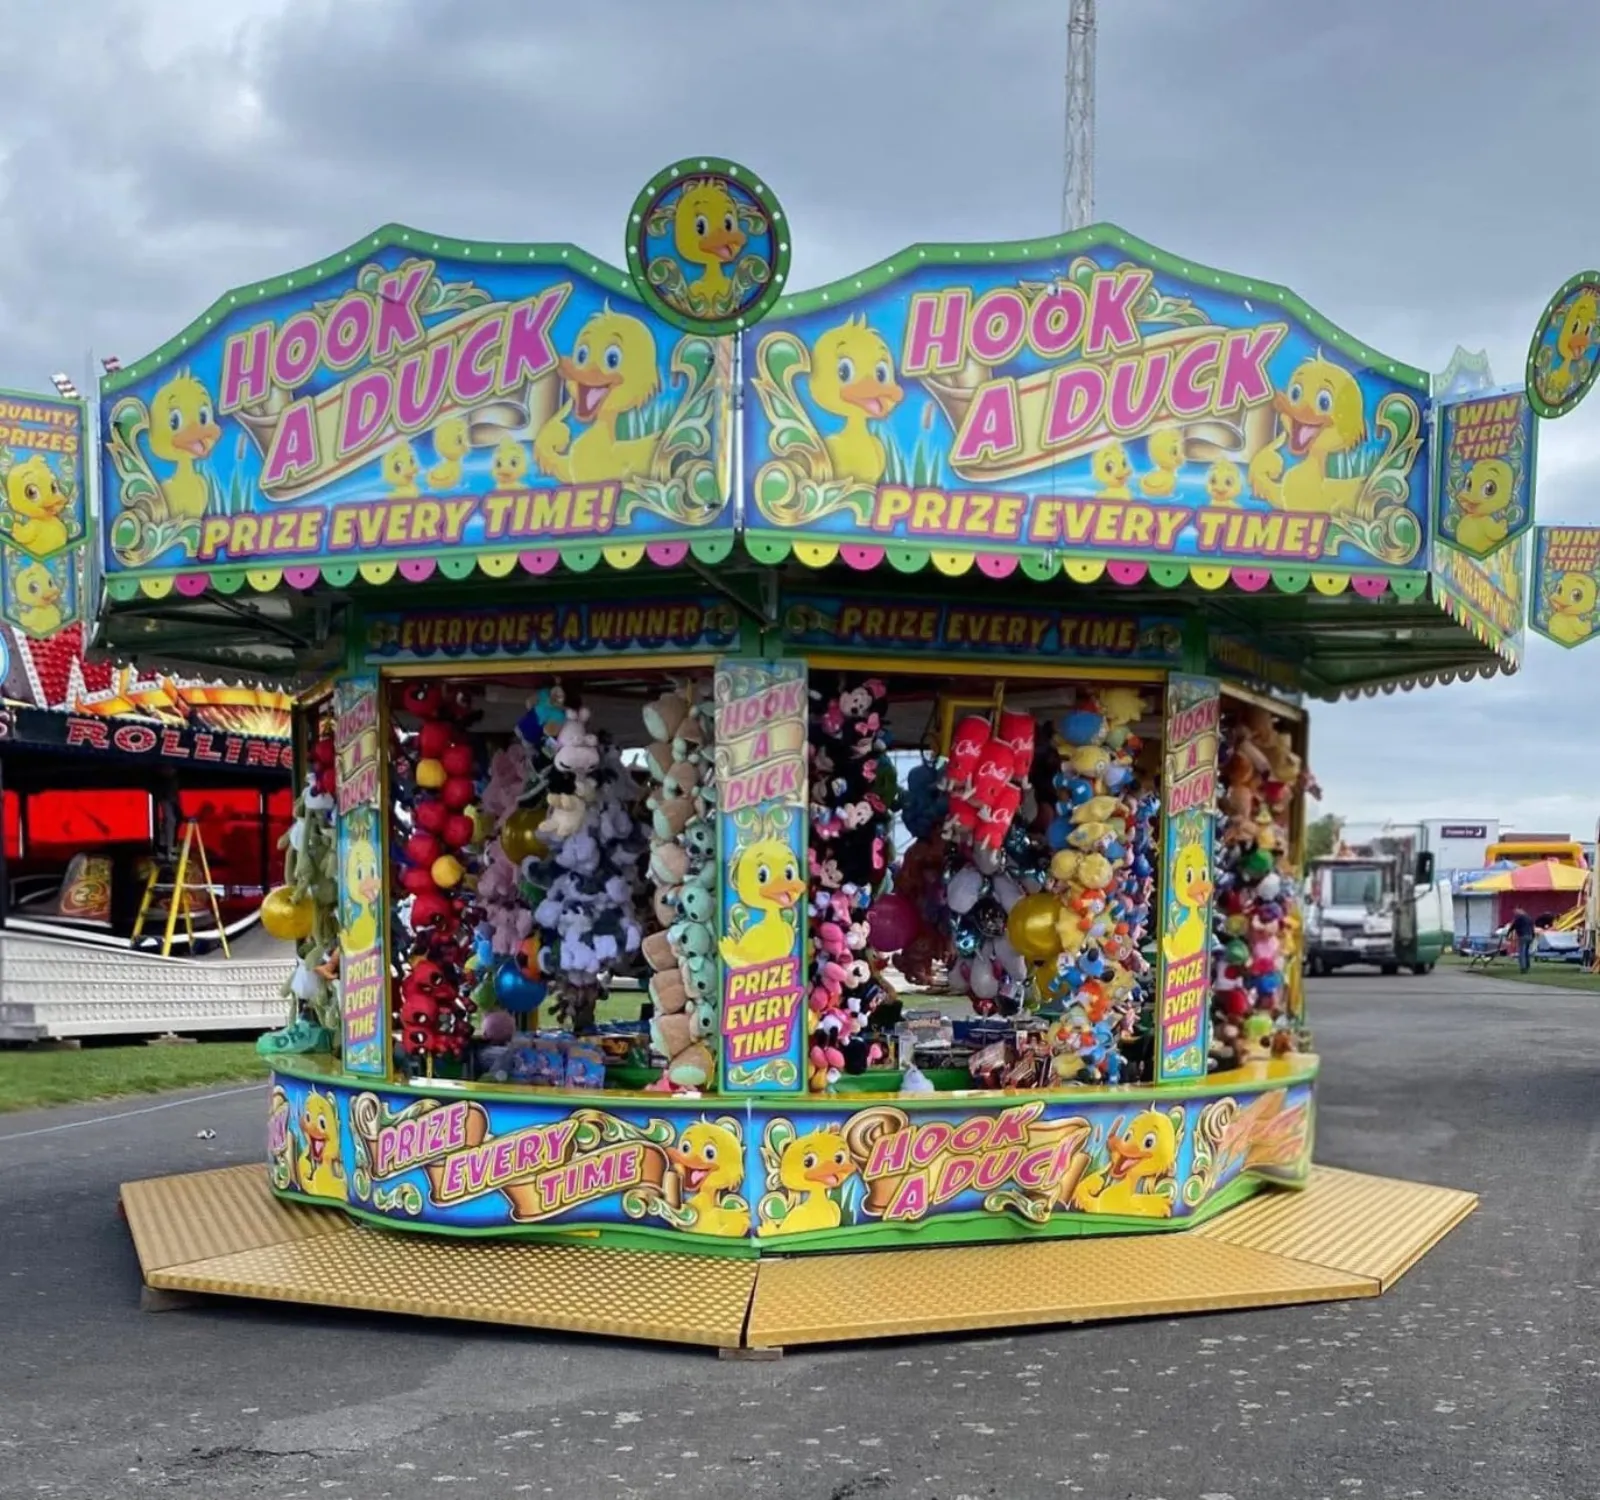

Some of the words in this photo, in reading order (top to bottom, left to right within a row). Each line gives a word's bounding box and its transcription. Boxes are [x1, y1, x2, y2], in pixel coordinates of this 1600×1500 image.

[219, 261, 435, 415] HOOK
[903, 269, 1152, 376] HOOK
[260, 398, 318, 491] A
[337, 282, 573, 460] DUCK
[951, 377, 1020, 466] A
[1044, 323, 1288, 449] DUCK
[1455, 421, 1516, 445] EVERY
[1459, 398, 1518, 427] WIN
[1463, 440, 1509, 459] TIME
[202, 510, 322, 556] PRIZE
[332, 500, 477, 548] EVERY
[487, 486, 618, 536] TIME!
[875, 490, 1026, 537] PRIZE
[1033, 499, 1189, 548] EVERY
[1199, 512, 1326, 558] TIME!
[402, 612, 555, 649] EVERYONE'S
[563, 611, 581, 640] A
[592, 606, 703, 639] WINNER
[840, 606, 938, 640] PRIZE
[946, 613, 1048, 644] EVERY
[1061, 618, 1137, 649] TIME
[722, 679, 804, 735] HOOK
[751, 730, 770, 761] A
[726, 761, 800, 812] DUCK
[346, 955, 376, 988] PRIZE
[729, 962, 795, 1000] PRIZE
[1167, 957, 1204, 992] PRIZE
[345, 982, 379, 1015] EVERY
[726, 992, 798, 1030] EVERY
[1164, 984, 1204, 1020] EVERY
[732, 1023, 787, 1058] TIME
[1168, 1014, 1198, 1047] TIME
[377, 1101, 470, 1176] PRIZE
[442, 1118, 579, 1200] EVERY
[864, 1101, 1045, 1180] HOOK
[537, 1143, 644, 1211] TIME
[884, 1169, 931, 1221] A
